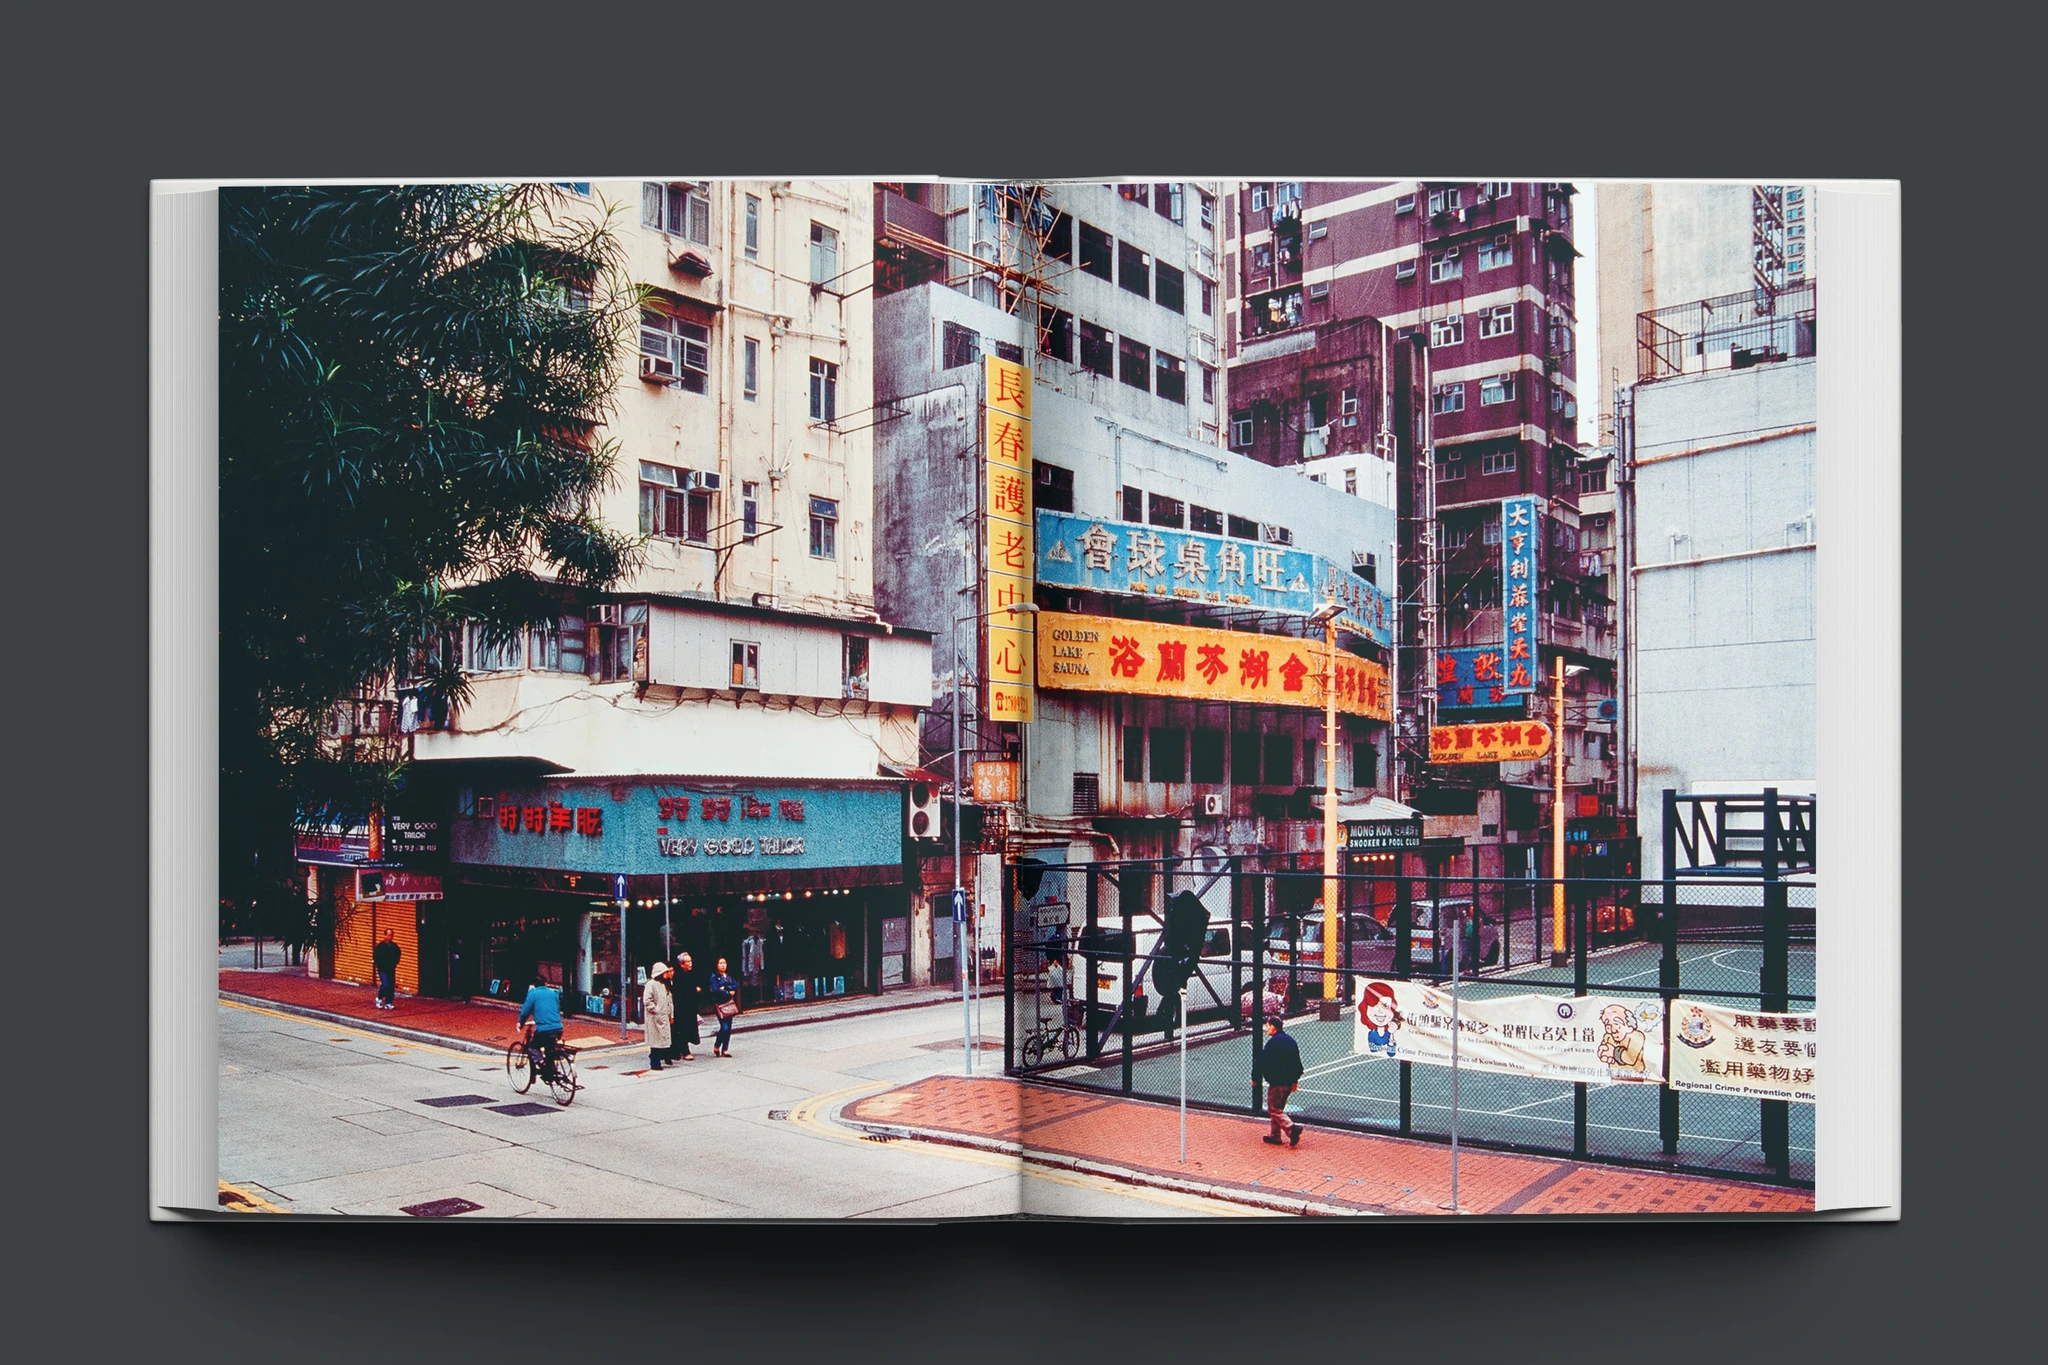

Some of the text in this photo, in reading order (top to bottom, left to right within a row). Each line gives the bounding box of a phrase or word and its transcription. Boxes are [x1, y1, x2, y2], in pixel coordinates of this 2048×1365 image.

[995, 367, 1027, 676] 長春護老中心
[1052, 629, 1099, 642] GOLDEN
[1052, 645, 1083, 659] LAKE
[1053, 662, 1090, 675] SAUNA
[1476, 751, 1498, 759] LAKE
[1512, 750, 1538, 758] SAUNA
[392, 822, 410, 830] VERY
[1350, 825, 1374, 837] MONG
[1376, 824, 1392, 836] KOK
[404, 831, 426, 839] TAILOR
[658, 835, 805, 856] VERY GOOD TAILOR
[1349, 838, 1381, 848] SNOOKER
[1388, 838, 1404, 847] POOL
[1405, 838, 1420, 846] CLUB
[1397, 1047, 1417, 1055] Crime
[1418, 1049, 1450, 1060] Prevention
[1479, 1057, 1508, 1068] Kowloon
[1675, 1080, 1712, 1090] Regional
[1714, 1083, 1741, 1092] Crime
[1743, 1086, 1792, 1098] Prevention
